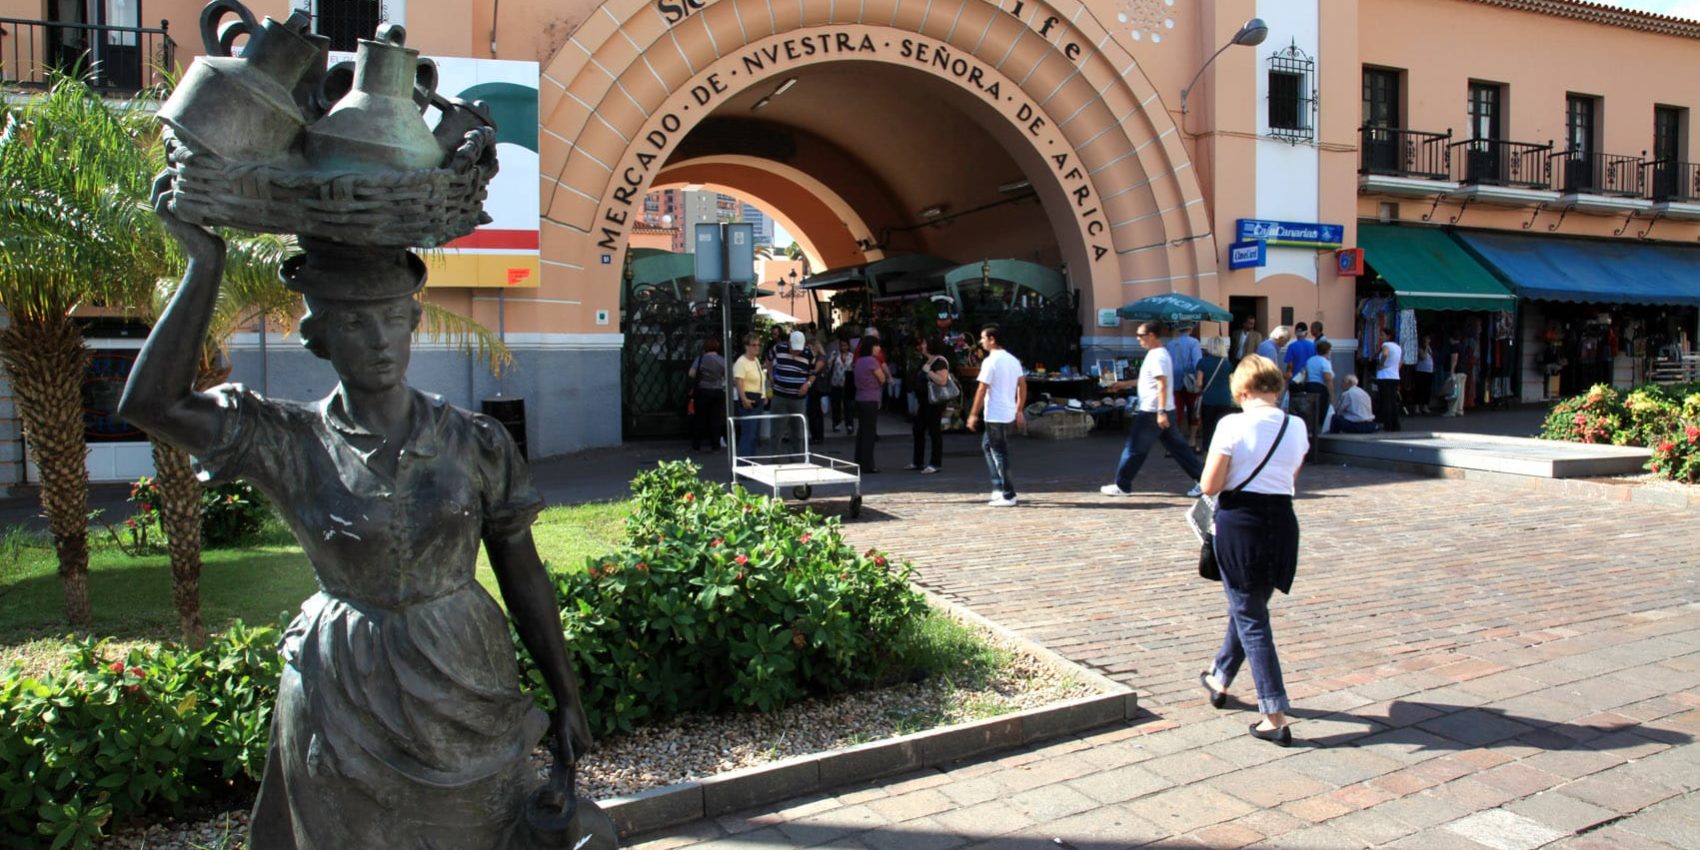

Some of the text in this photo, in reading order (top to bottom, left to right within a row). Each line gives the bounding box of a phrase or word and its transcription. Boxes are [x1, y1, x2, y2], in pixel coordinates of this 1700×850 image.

[598, 32, 1109, 262] MERCADO DE NVESTRA SEÑORA DE AFRICA
[1253, 224, 1318, 240] CajaCanarias
